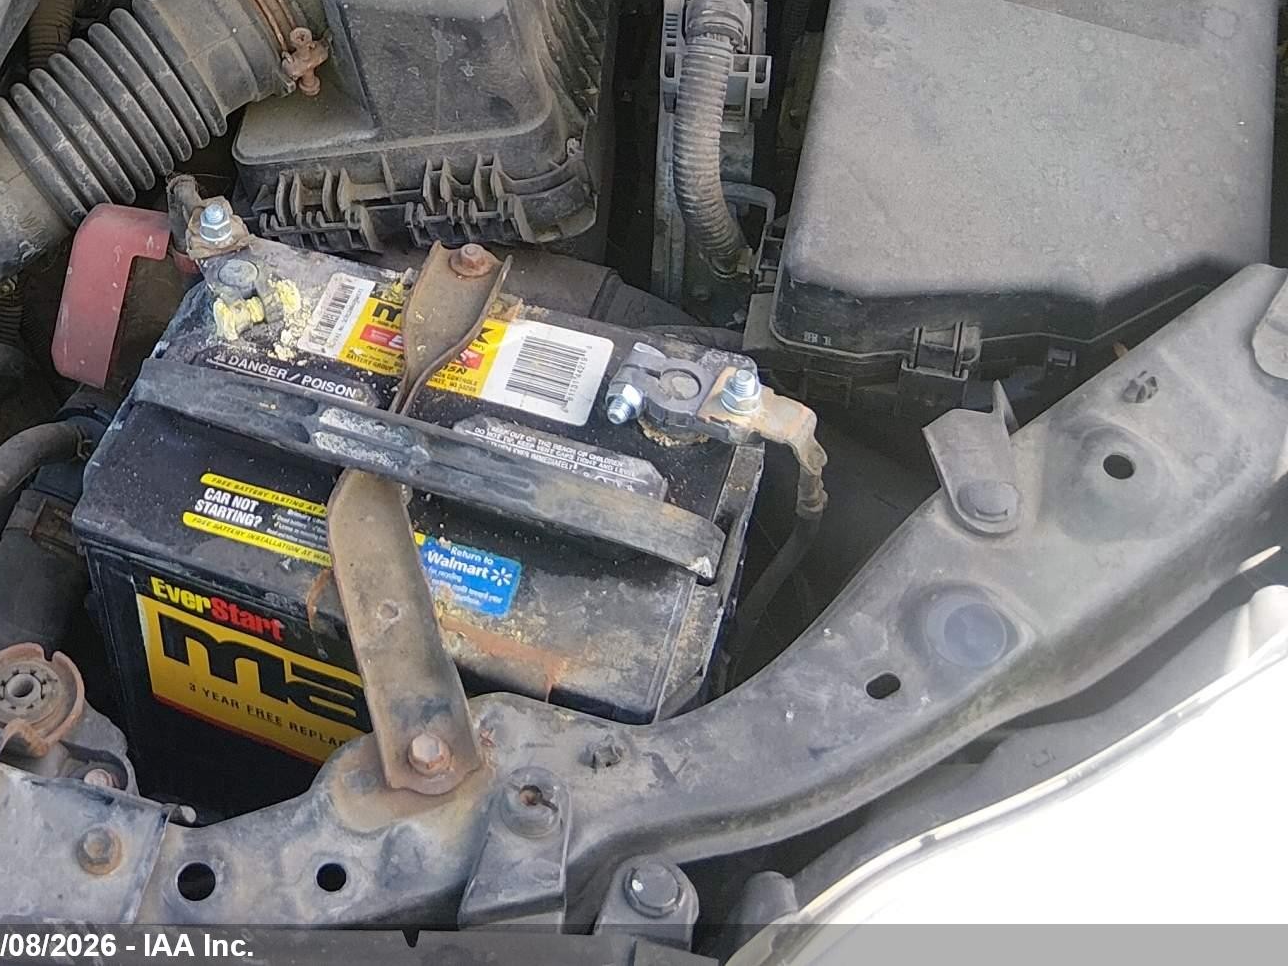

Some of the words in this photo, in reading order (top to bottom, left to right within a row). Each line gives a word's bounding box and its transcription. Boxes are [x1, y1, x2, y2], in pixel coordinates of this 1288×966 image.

[228, 353, 288, 379] DANGER
[287, 372, 302, 383] /
[301, 375, 357, 399] POISON
[474, 427, 486, 435] DO
[486, 431, 503, 440] NOT
[598, 463, 614, 471] AND
[510, 431, 526, 440] OUT
[537, 439, 552, 447] THE
[552, 443, 577, 454] REACH
[588, 452, 624, 467] CHILDREN
[194, 498, 263, 528] STARTING?
[203, 487, 231, 506] CAR
[231, 495, 260, 513] NOT
[211, 477, 233, 488] FREE
[234, 483, 268, 499] BATTERY
[271, 492, 305, 509] TESTING
[306, 504, 319, 512] AT
[192, 516, 212, 527] FREE
[213, 521, 246, 537] BATTERY
[247, 530, 300, 554] INSTALLATION
[301, 548, 313, 557] AT
[314, 553, 330, 564] WAL
[450, 546, 482, 562] Return
[483, 554, 494, 566] to
[427, 549, 490, 579] Walmart
[149, 575, 286, 643] EverStart
[157, 611, 375, 735] ma
[201, 686, 240, 709] YEAR
[246, 703, 283, 727] FREE
[289, 721, 347, 748] REPLAC
